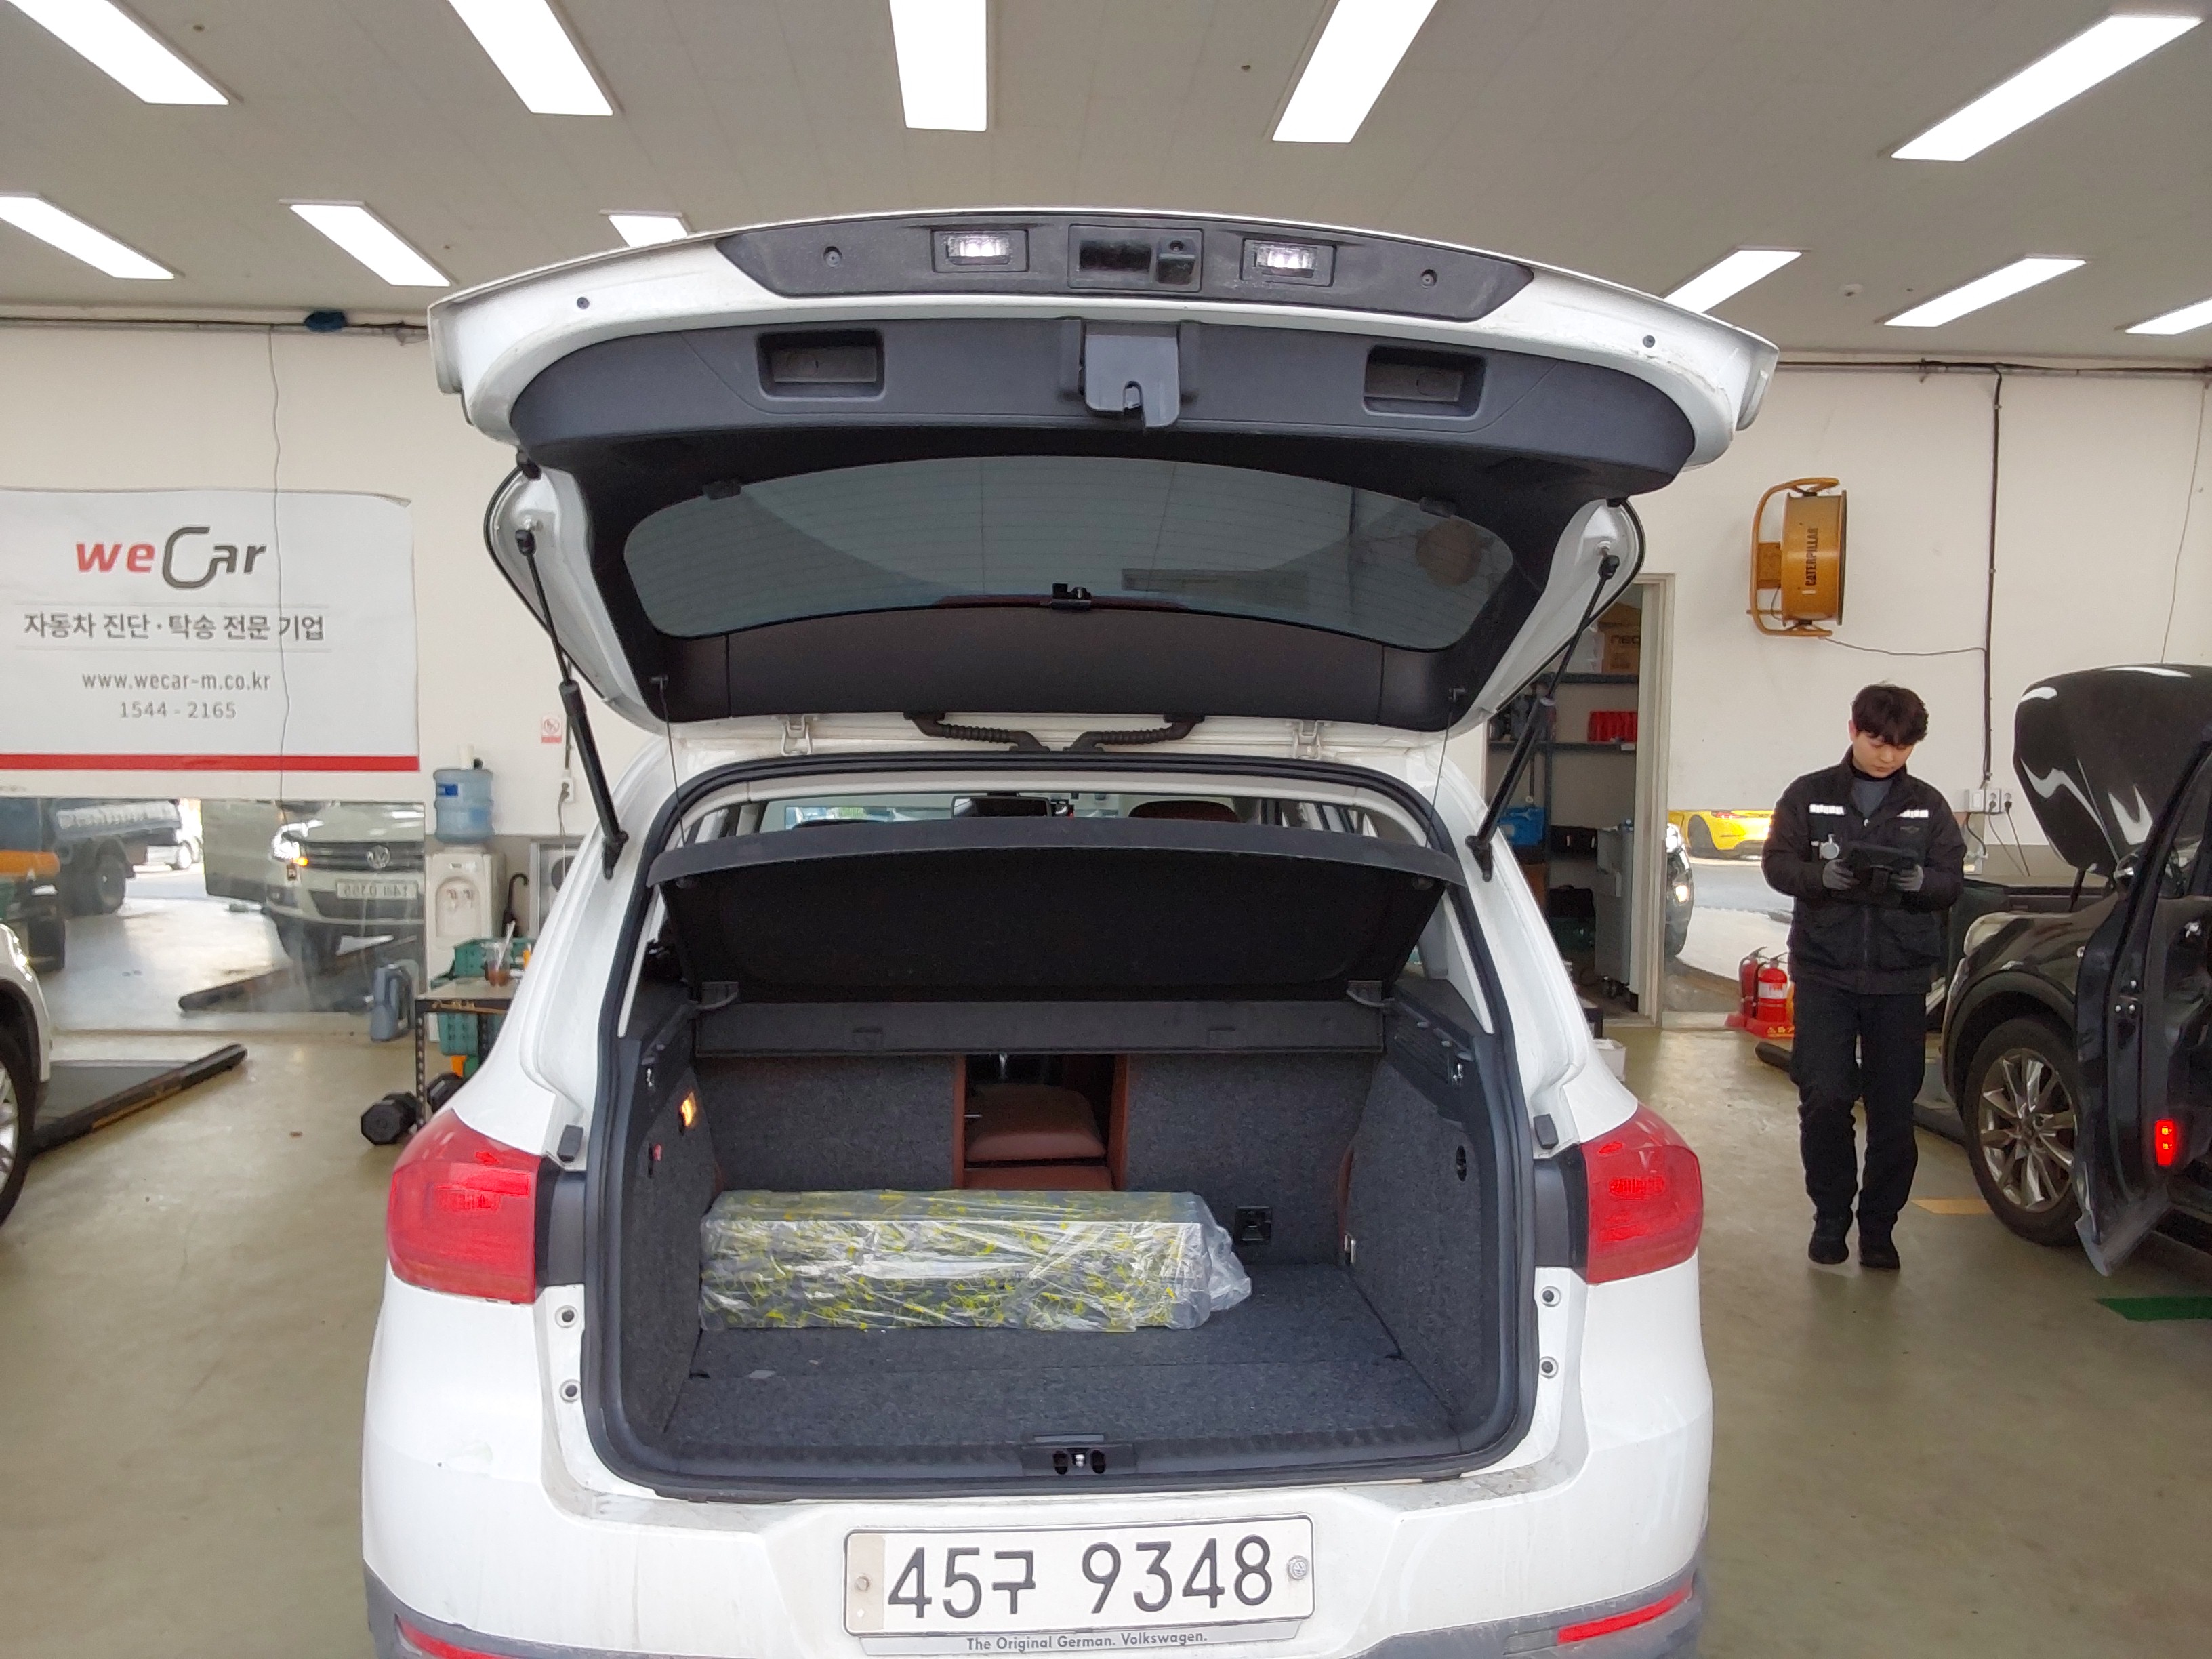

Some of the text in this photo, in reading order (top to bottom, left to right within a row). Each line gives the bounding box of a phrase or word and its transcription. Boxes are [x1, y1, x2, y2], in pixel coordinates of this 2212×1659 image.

[1805, 528, 1818, 586] CATERPILLAR
[24, 612, 97, 639] 자동차
[103, 613, 150, 640] 진단
[168, 614, 216, 640] 탁송
[223, 614, 271, 640] 전문
[278, 614, 325, 641] 기업
[82, 671, 271, 691] www.wecar-m.co.kr
[888, 1533, 1273, 1618] 45구 9348
[966, 1632, 1208, 1655] The Original German. Volkswagen.
